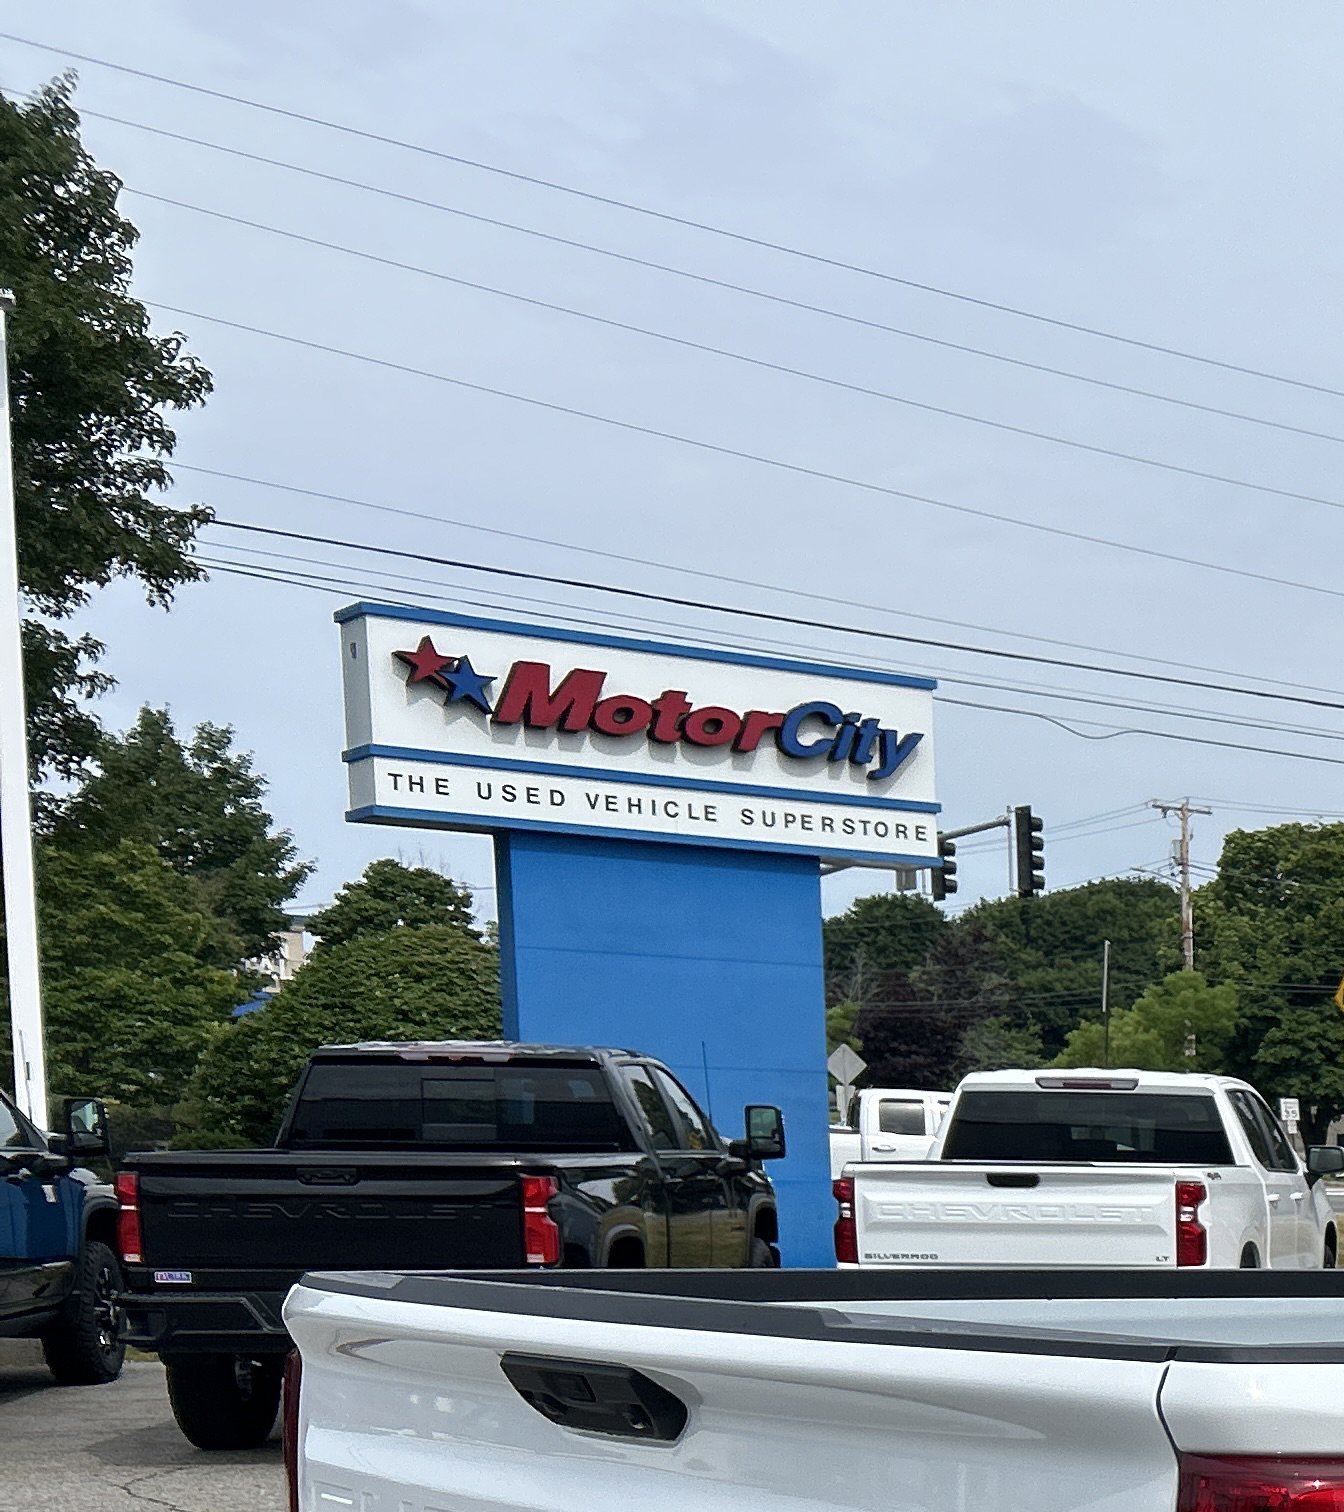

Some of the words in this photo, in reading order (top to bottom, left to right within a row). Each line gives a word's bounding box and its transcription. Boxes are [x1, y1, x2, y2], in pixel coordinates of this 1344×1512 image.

[491, 660, 923, 781] MotorCity
[388, 773, 450, 797] THE
[477, 781, 566, 807] USED
[586, 792, 718, 822] VEHICLE
[741, 808, 927, 842] SUPERSTORE
